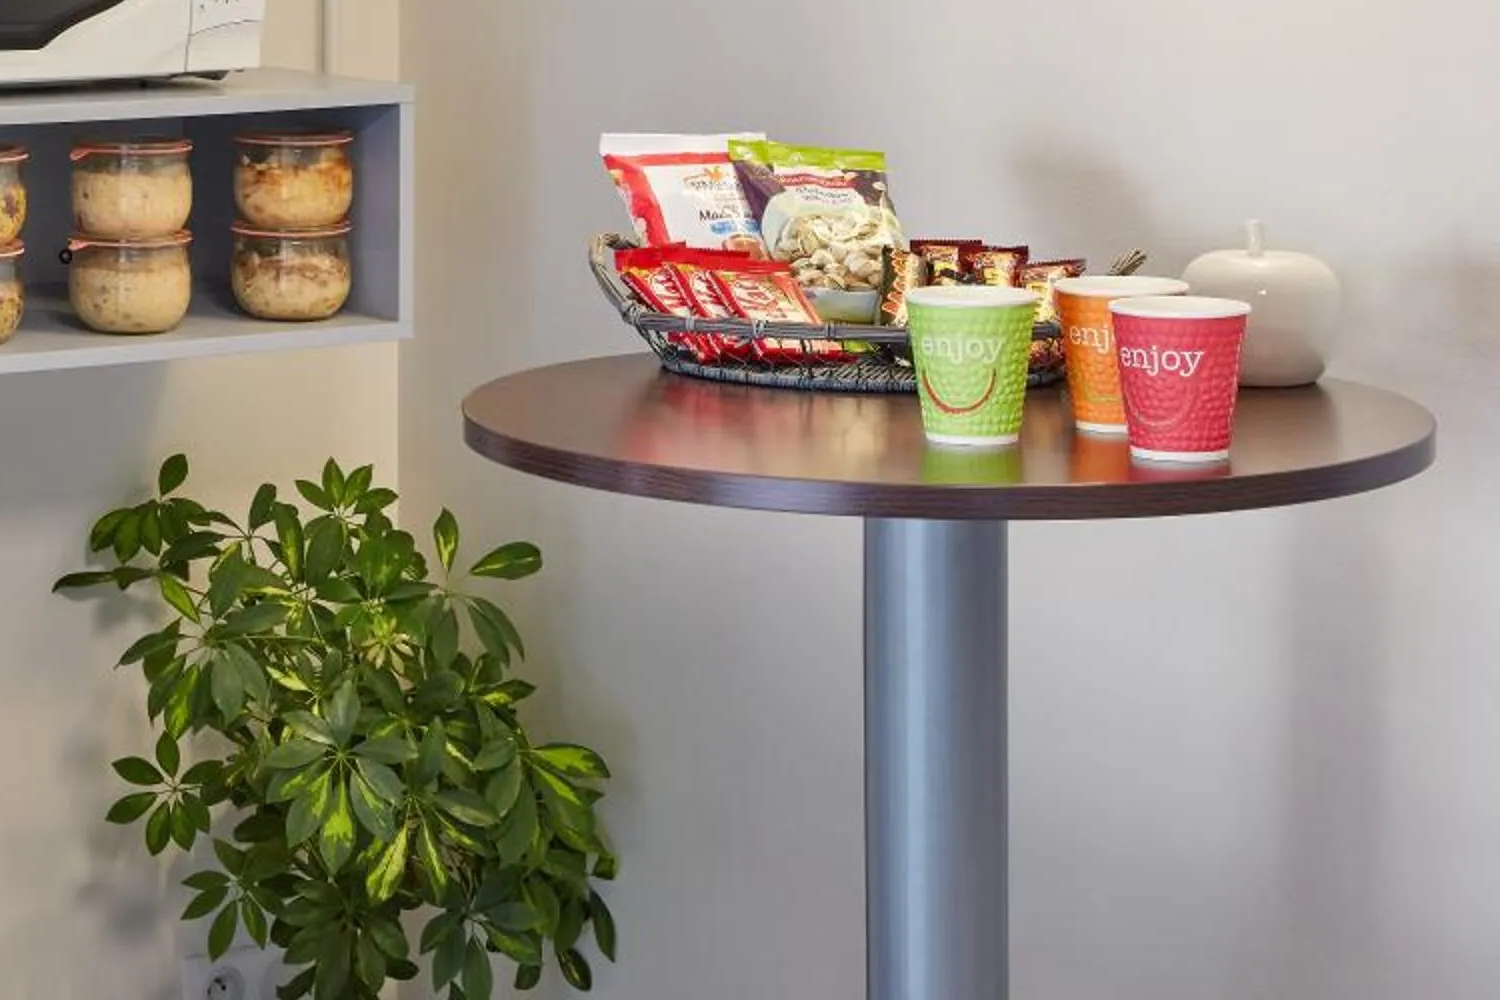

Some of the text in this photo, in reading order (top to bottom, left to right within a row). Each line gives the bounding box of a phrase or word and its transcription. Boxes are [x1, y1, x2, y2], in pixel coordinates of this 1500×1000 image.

[921, 334, 1005, 364] enjoy
[1068, 325, 1114, 355] enj
[1120, 345, 1205, 377] enjoy
